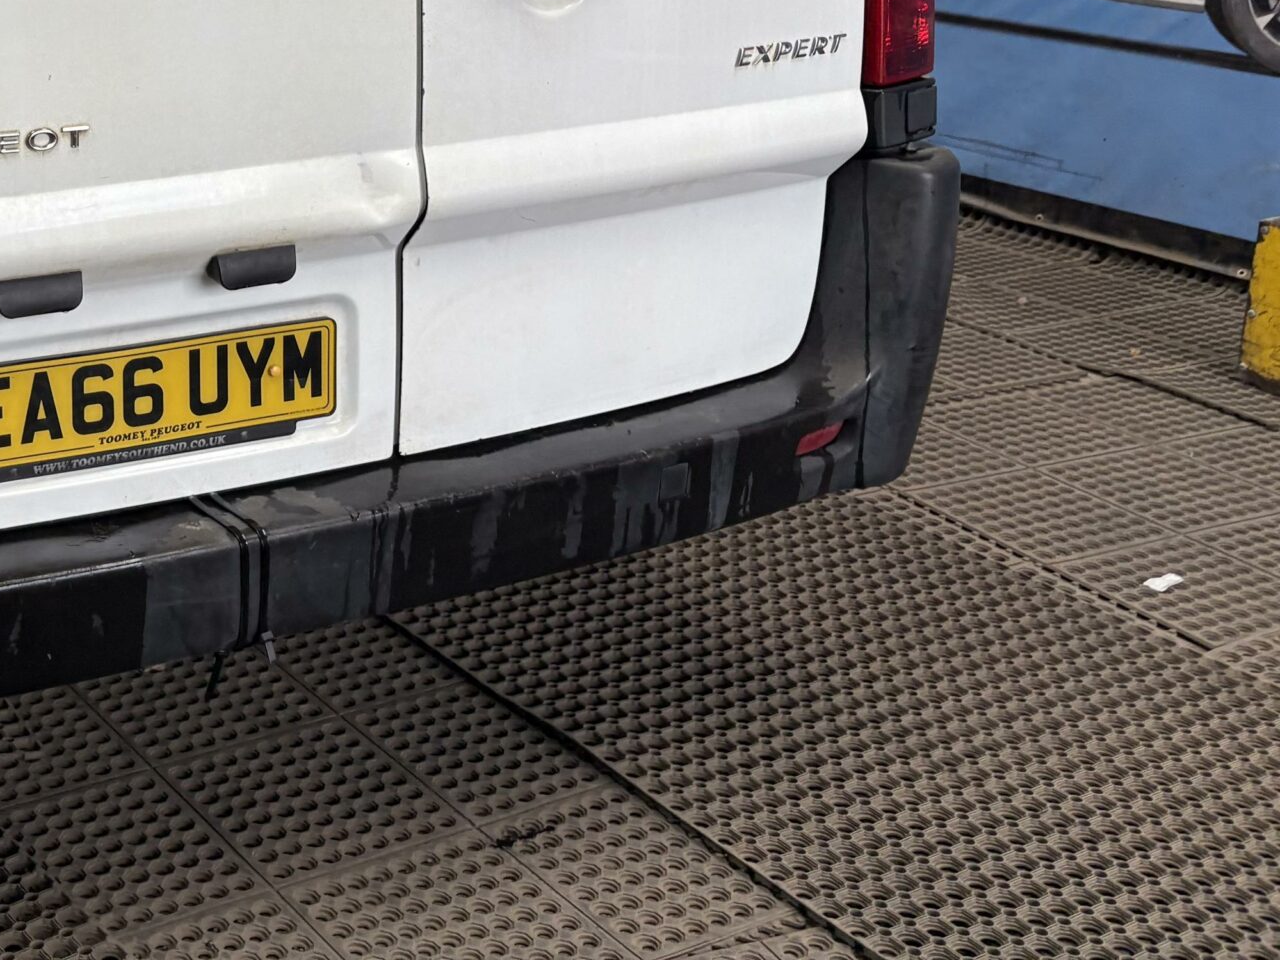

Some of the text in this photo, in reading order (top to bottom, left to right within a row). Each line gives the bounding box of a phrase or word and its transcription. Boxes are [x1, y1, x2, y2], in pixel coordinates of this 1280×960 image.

[734, 33, 847, 67] EXPERT
[188, 331, 323, 416] UYM
[99, 431, 146, 444] TOOMEY
[150, 421, 202, 436] PEUGEOT
